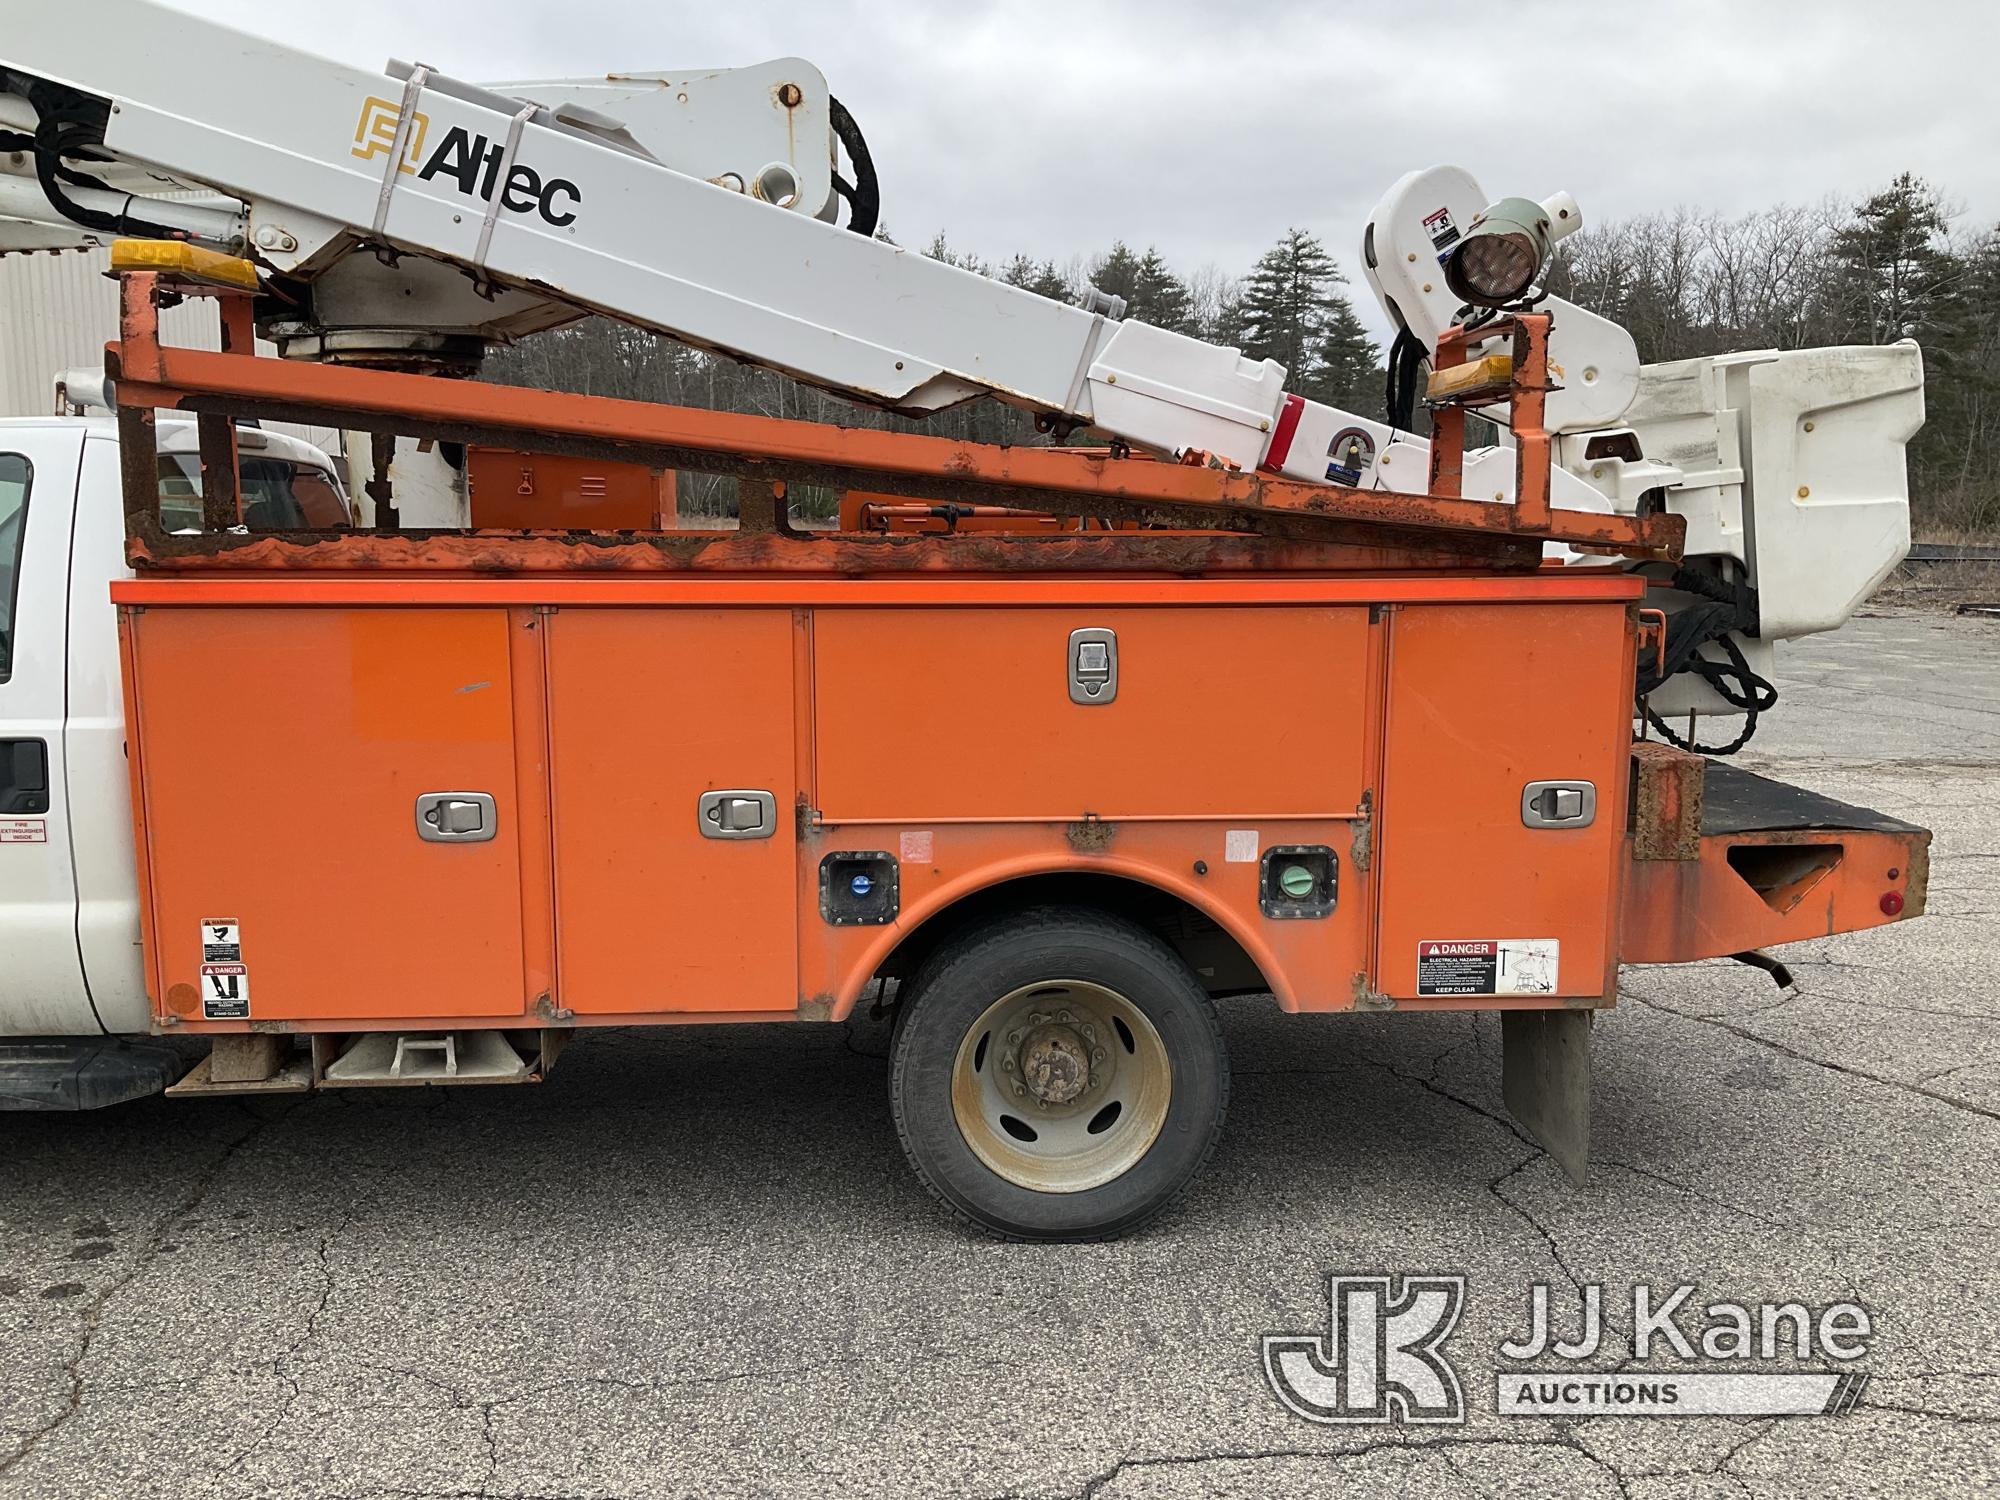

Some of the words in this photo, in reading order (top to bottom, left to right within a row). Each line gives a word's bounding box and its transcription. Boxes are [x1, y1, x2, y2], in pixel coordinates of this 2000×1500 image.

[417, 125, 582, 227] Altec
[1441, 943, 1489, 954] DANGER
[215, 966, 243, 974] DANGER
